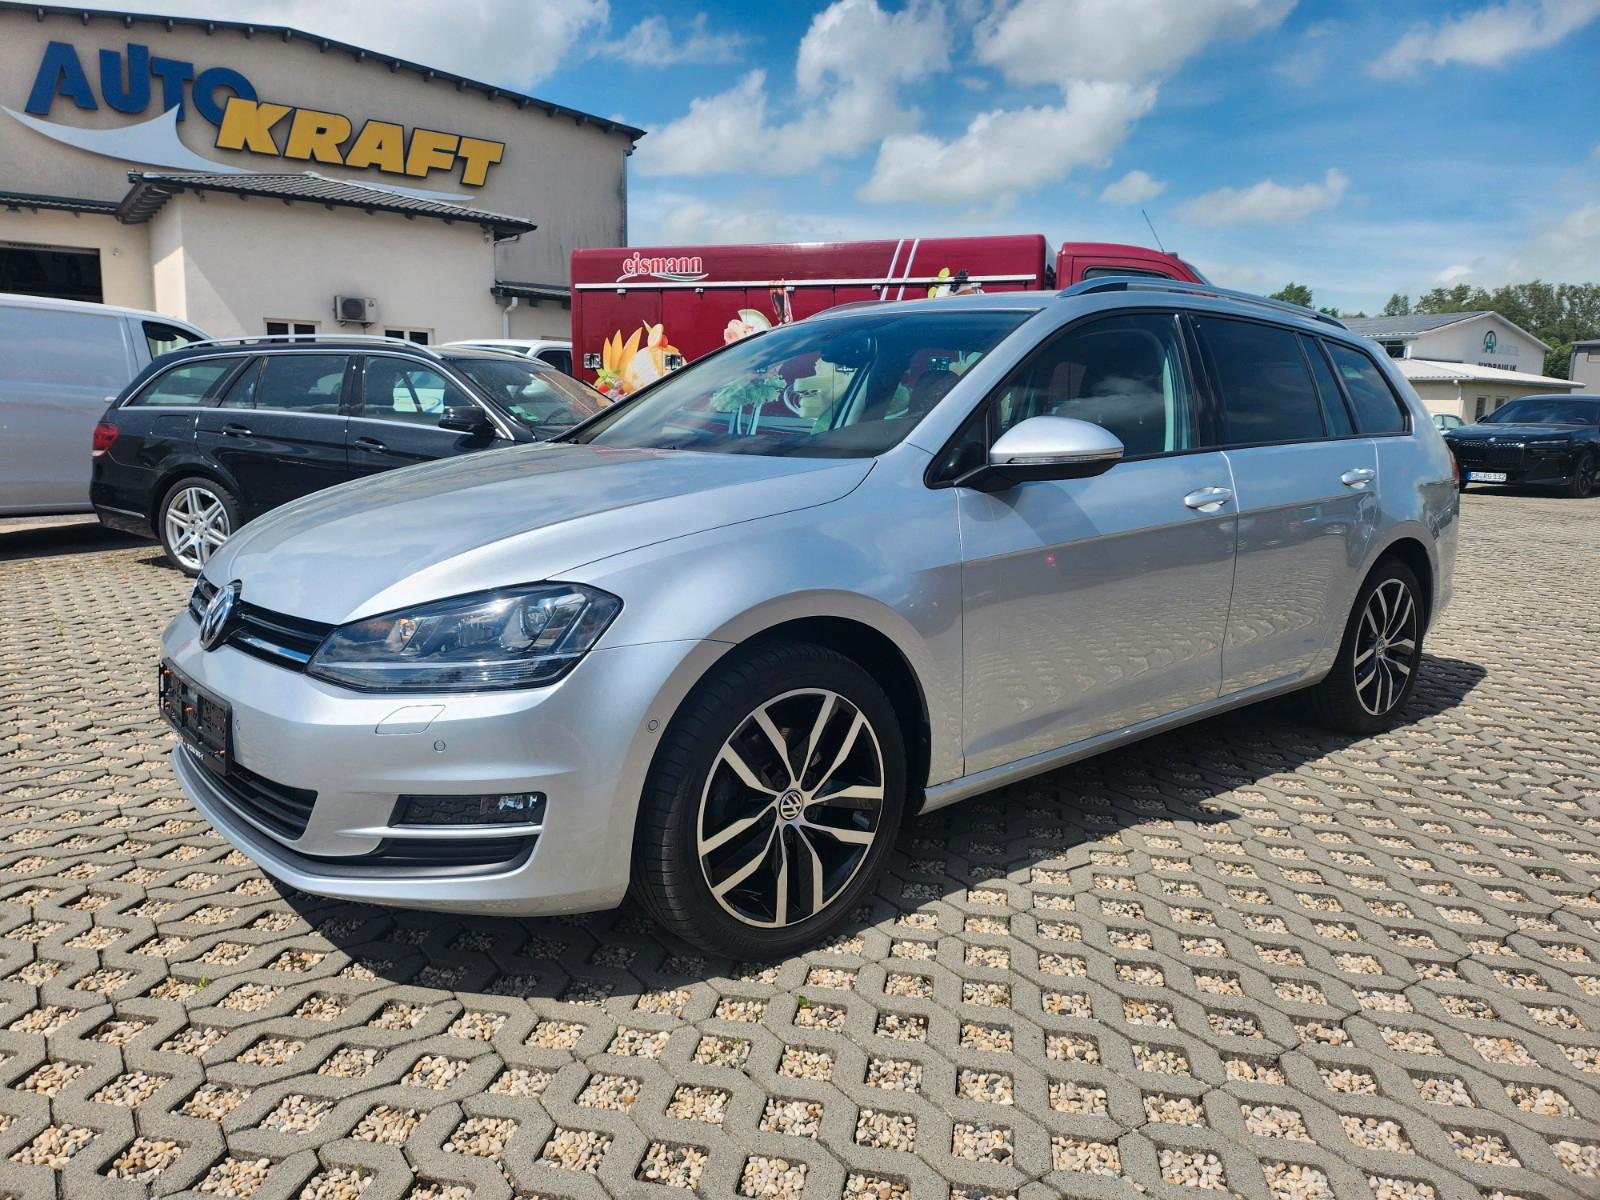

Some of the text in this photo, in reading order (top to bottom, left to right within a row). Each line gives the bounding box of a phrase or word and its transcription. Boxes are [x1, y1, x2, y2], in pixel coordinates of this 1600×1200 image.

[25, 40, 506, 187] AUTO KRAFT
[622, 251, 703, 275] eismann
